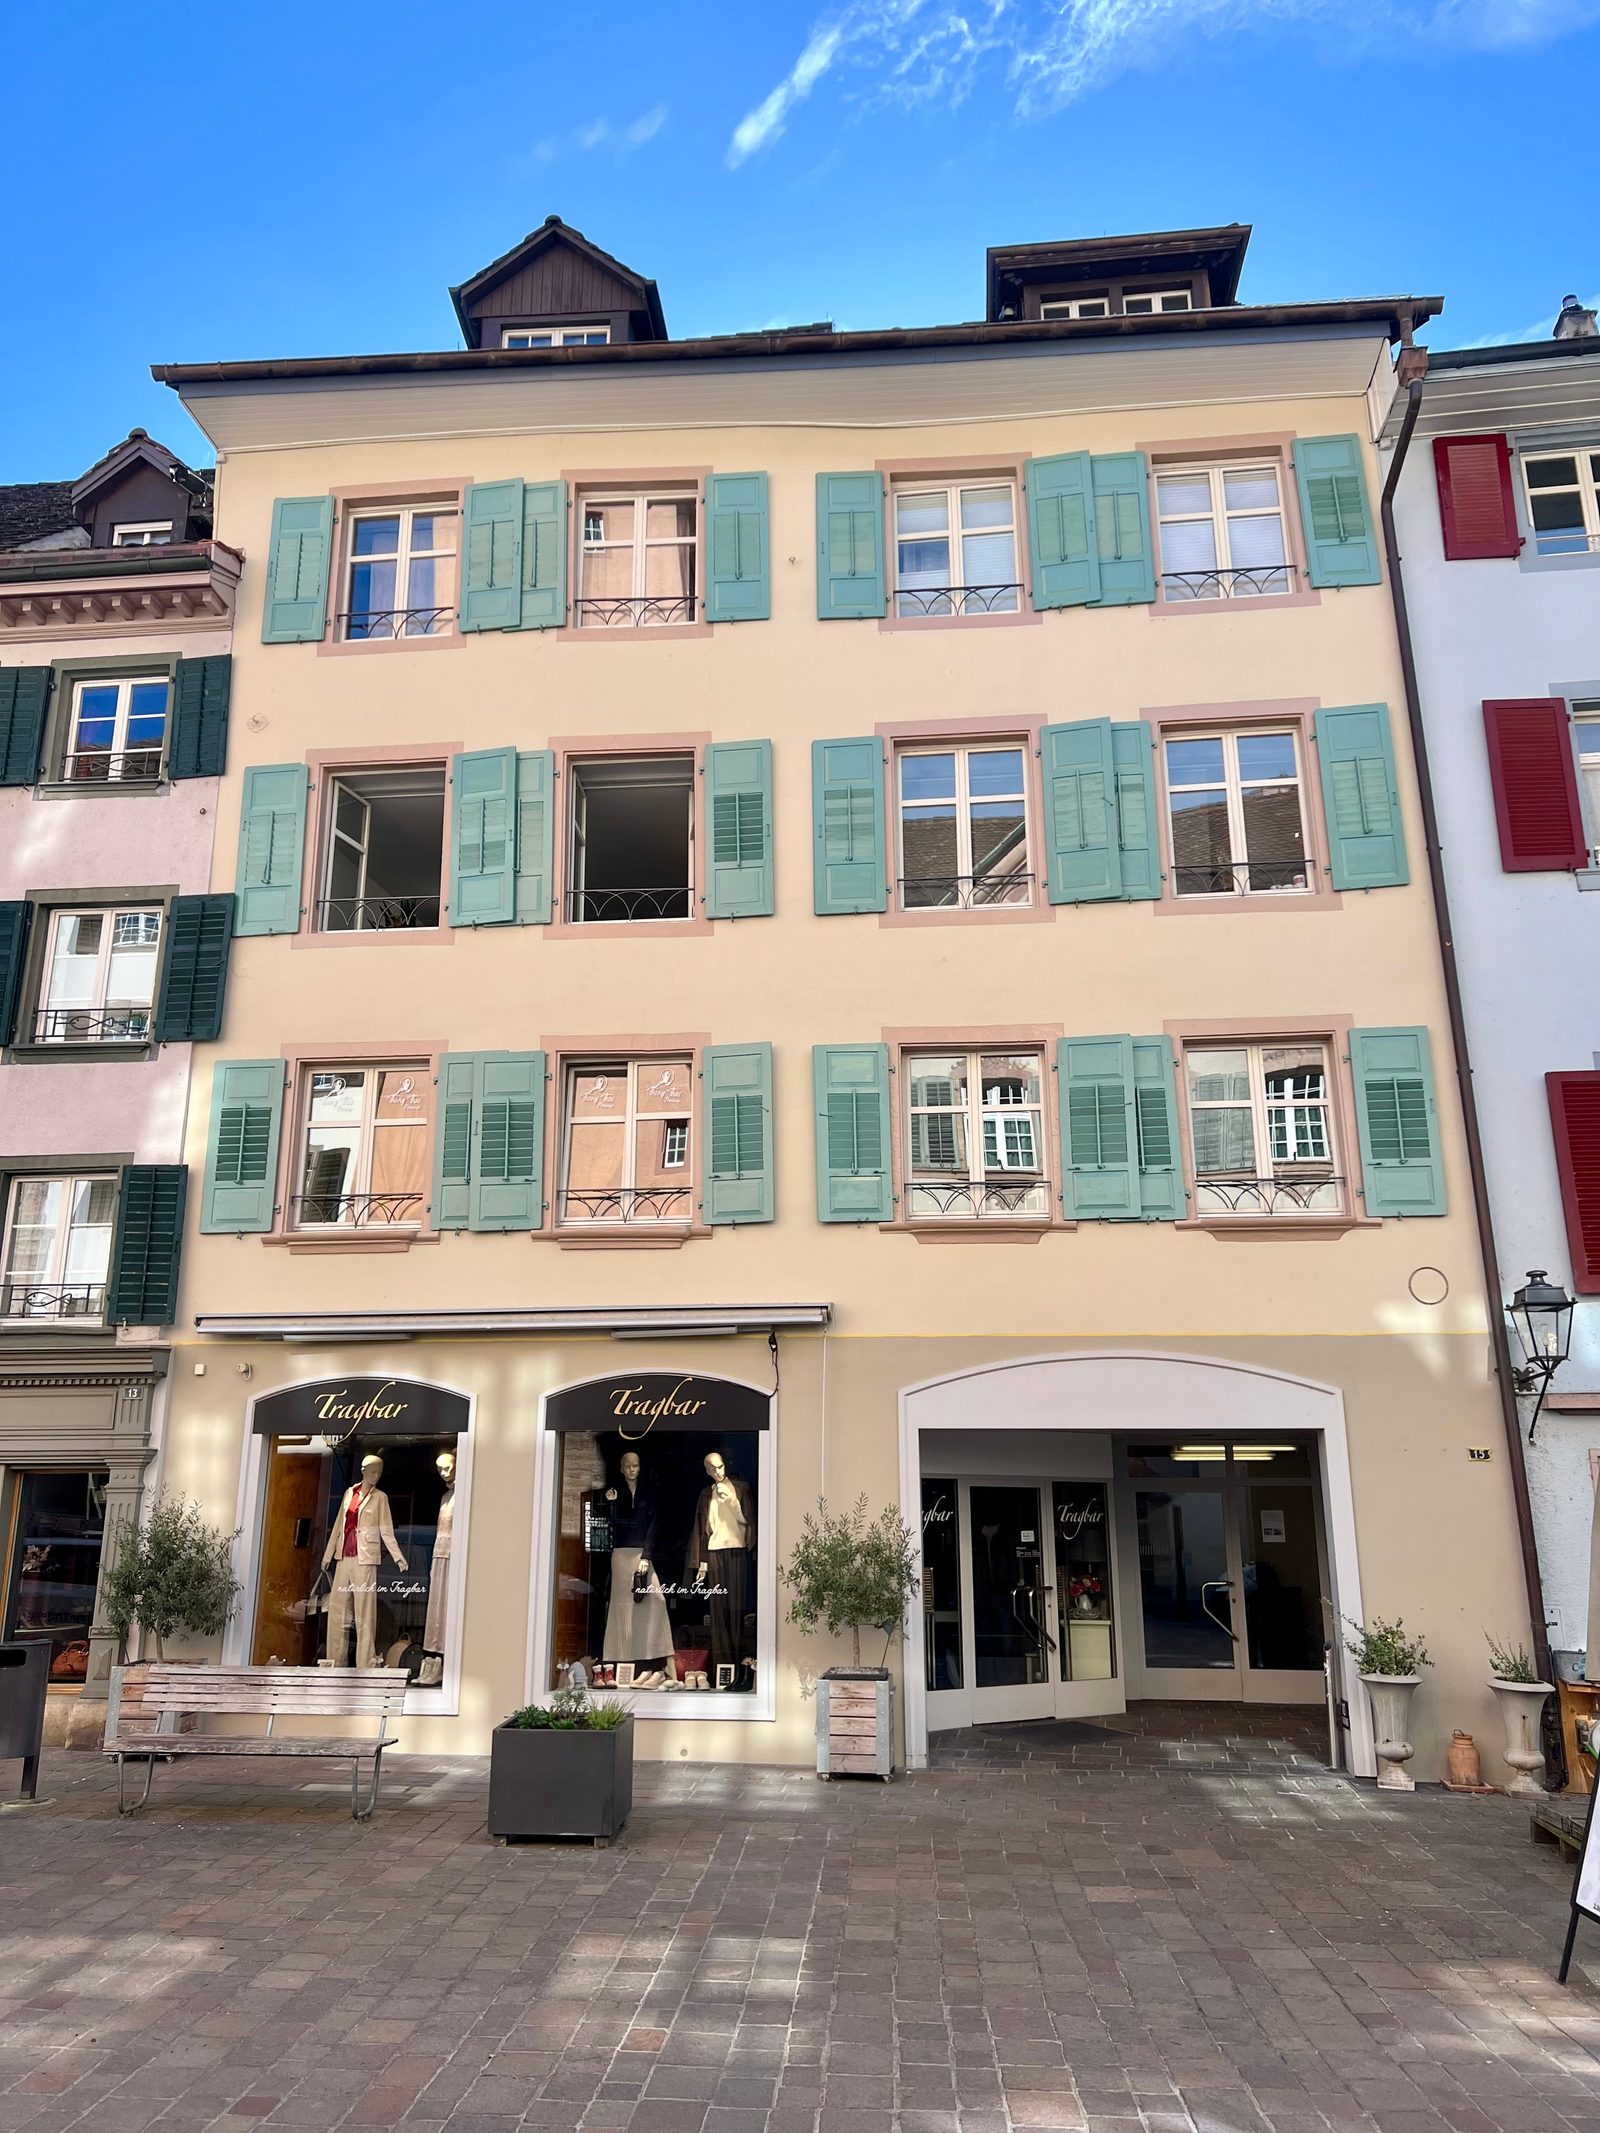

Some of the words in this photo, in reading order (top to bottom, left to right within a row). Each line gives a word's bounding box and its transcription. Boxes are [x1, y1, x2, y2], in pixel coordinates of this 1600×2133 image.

[128, 1388, 138, 1398] 13
[314, 1381, 408, 1446] Tragbar
[609, 1377, 707, 1440] Tragbar
[1474, 1449, 1485, 1459] 15
[921, 1495, 954, 1534] gbar
[1057, 1497, 1104, 1540] Tragbar
[336, 1582, 376, 1593] natürlich
[377, 1584, 388, 1593] im
[390, 1580, 427, 1598] Tragbar
[635, 1583, 675, 1594] natürlich
[677, 1586, 689, 1594] im
[690, 1582, 729, 1600] Tragbar
